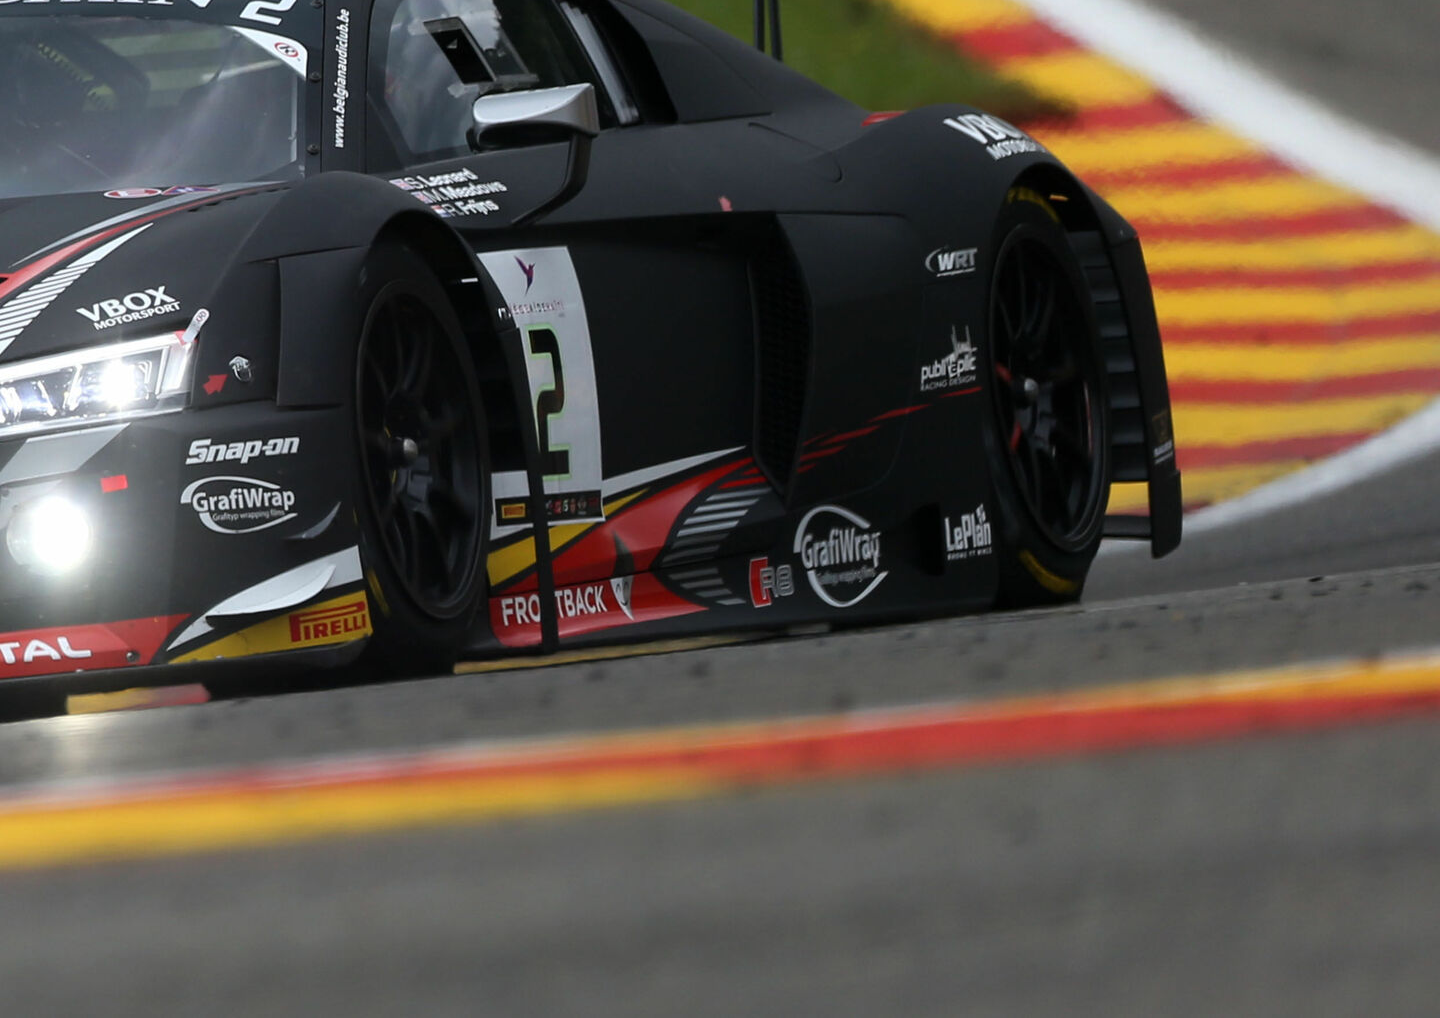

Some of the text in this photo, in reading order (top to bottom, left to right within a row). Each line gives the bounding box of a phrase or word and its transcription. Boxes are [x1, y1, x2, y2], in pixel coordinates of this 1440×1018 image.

[332, 8, 350, 149] www.belgianaudiclub.be
[937, 248, 978, 272] WRT
[76, 285, 176, 323] VBOX
[93, 301, 181, 331] MOTORSPORT
[526, 324, 573, 480] 2
[185, 437, 300, 465] Snap-on
[192, 487, 295, 512] GrafiWrap
[944, 513, 992, 551] LePlan
[289, 601, 367, 642] PIRELLI
[501, 585, 608, 627] FROTBACK
